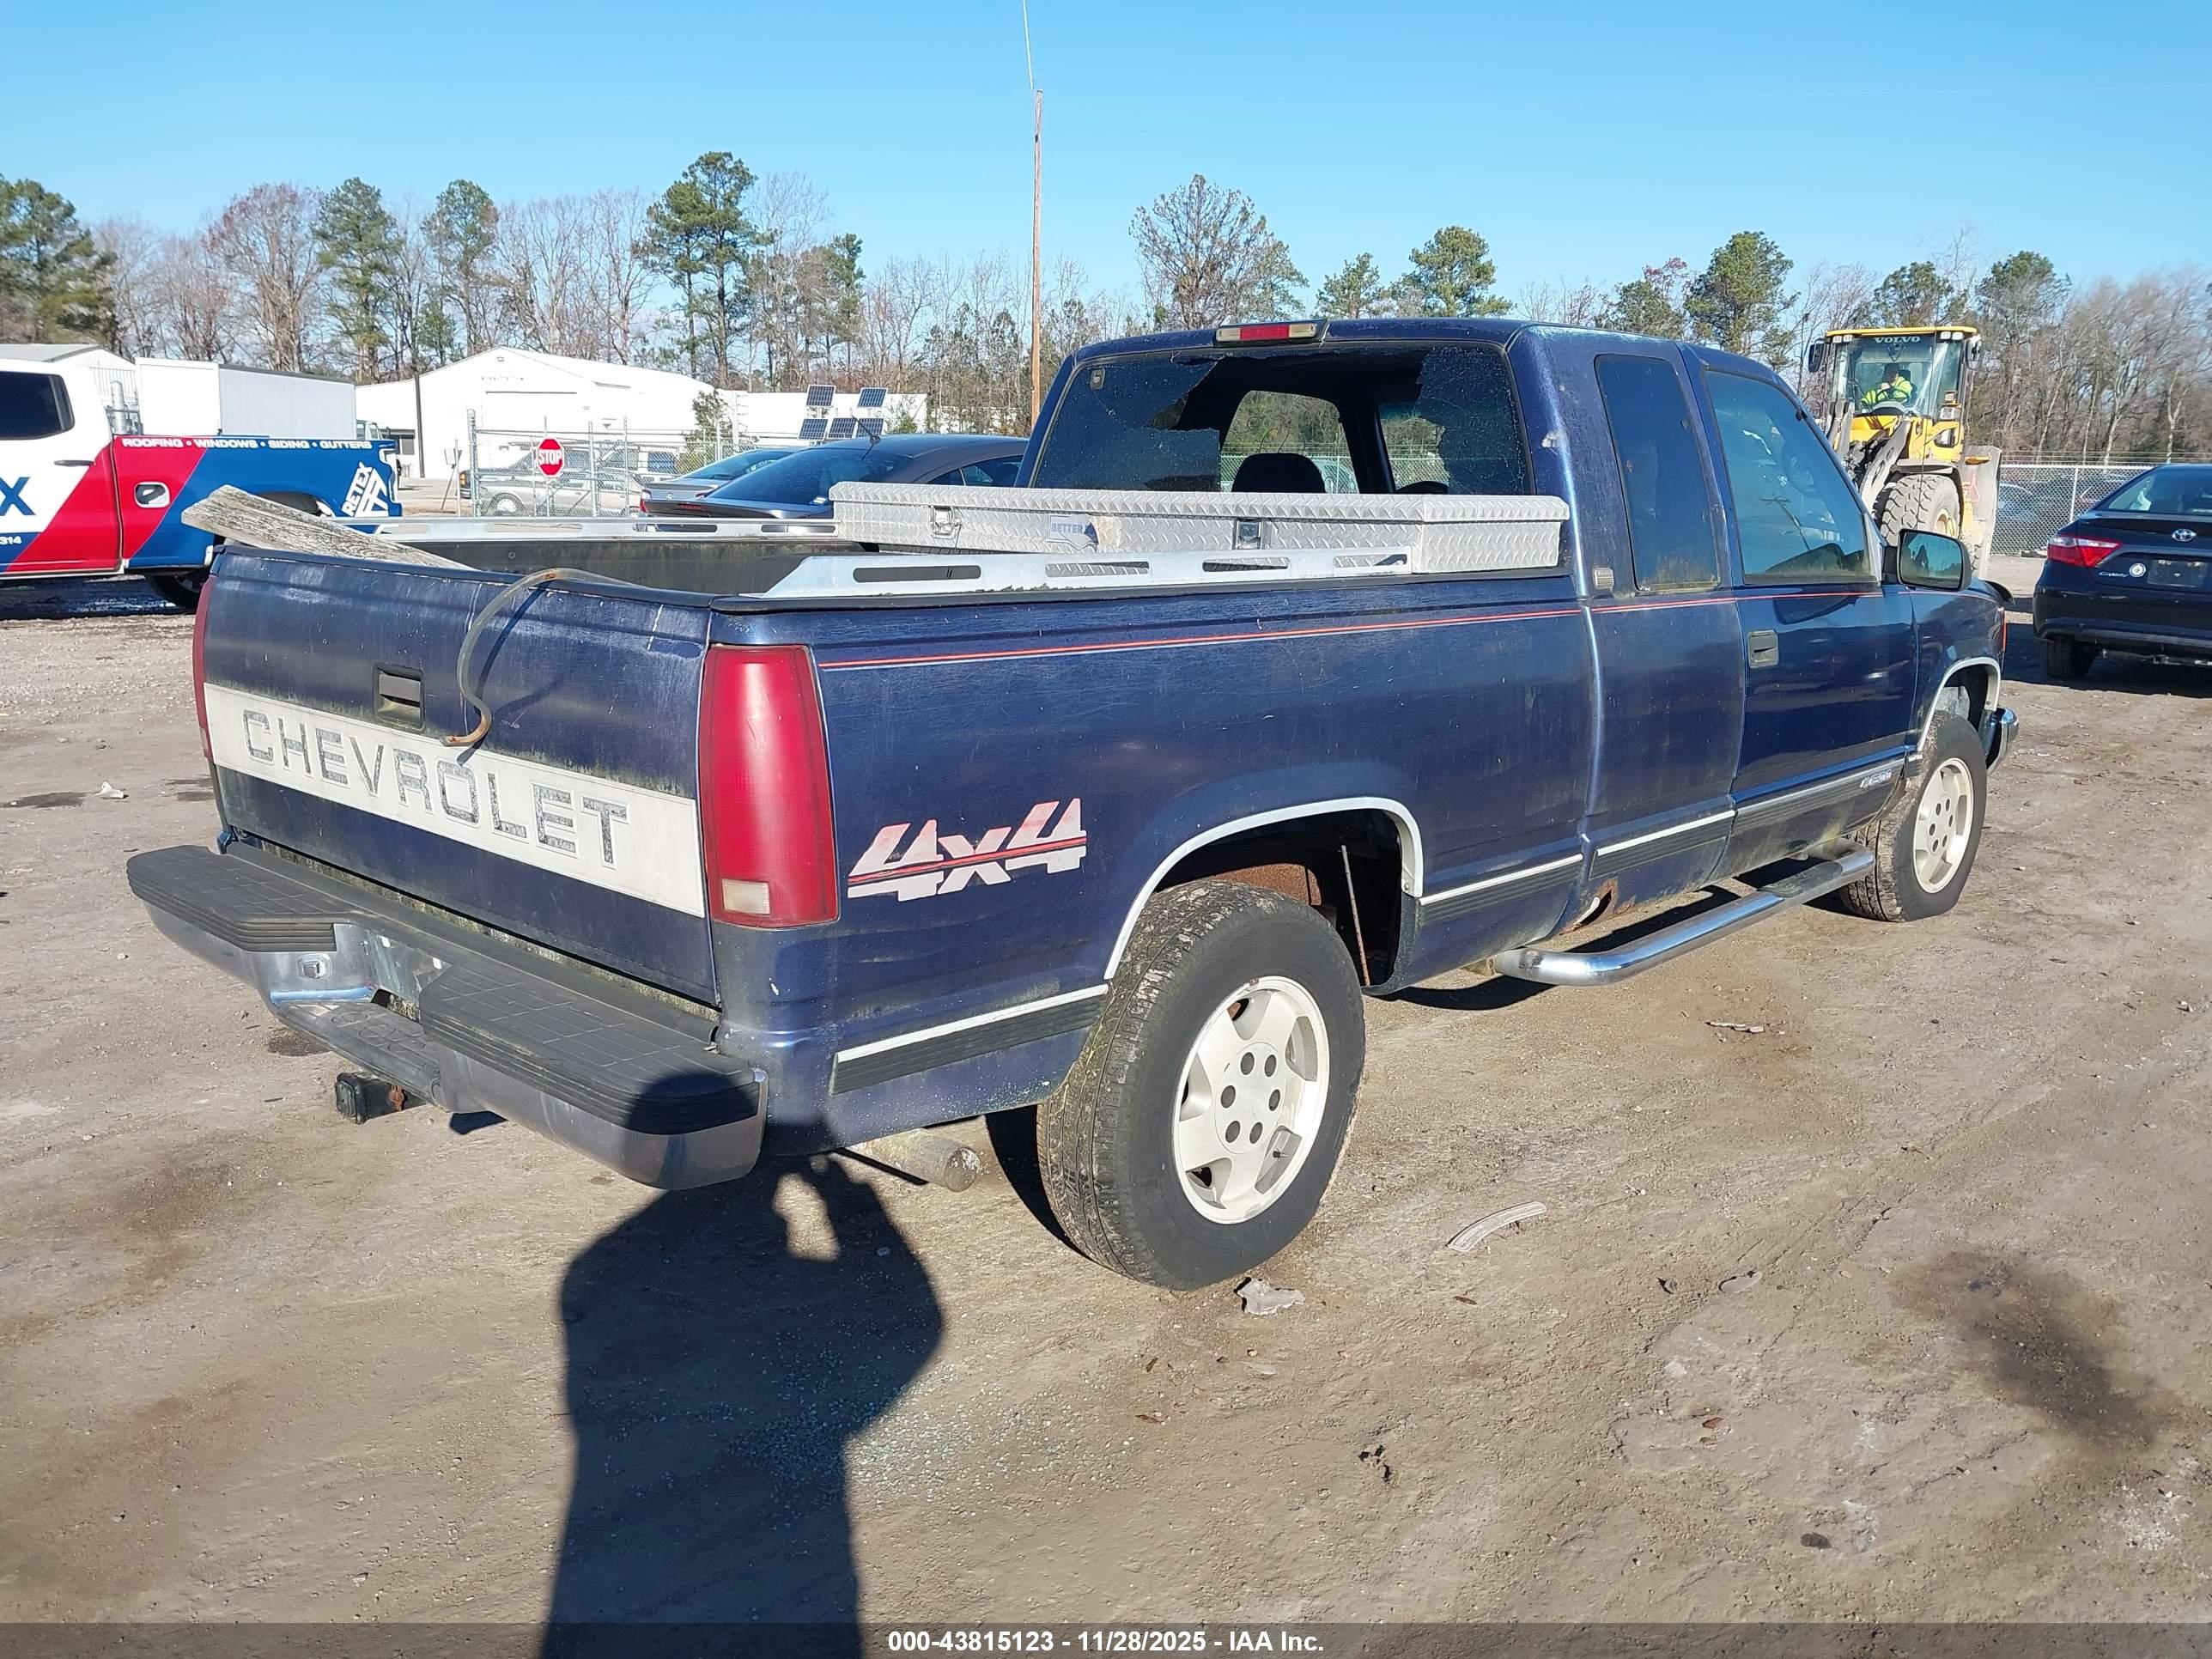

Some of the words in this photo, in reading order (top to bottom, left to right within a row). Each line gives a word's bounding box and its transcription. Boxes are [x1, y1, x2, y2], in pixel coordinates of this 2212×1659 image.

[121, 438, 184, 447] ROOFING
[192, 439, 258, 448] WINDOWS
[268, 440, 310, 449] SIDING
[319, 441, 372, 449] GUTTERS
[538, 449, 562, 465] STOP
[341, 461, 373, 517] RETEX
[1051, 522, 1083, 533] BETTER
[241, 708, 631, 870] CHEVROLET
